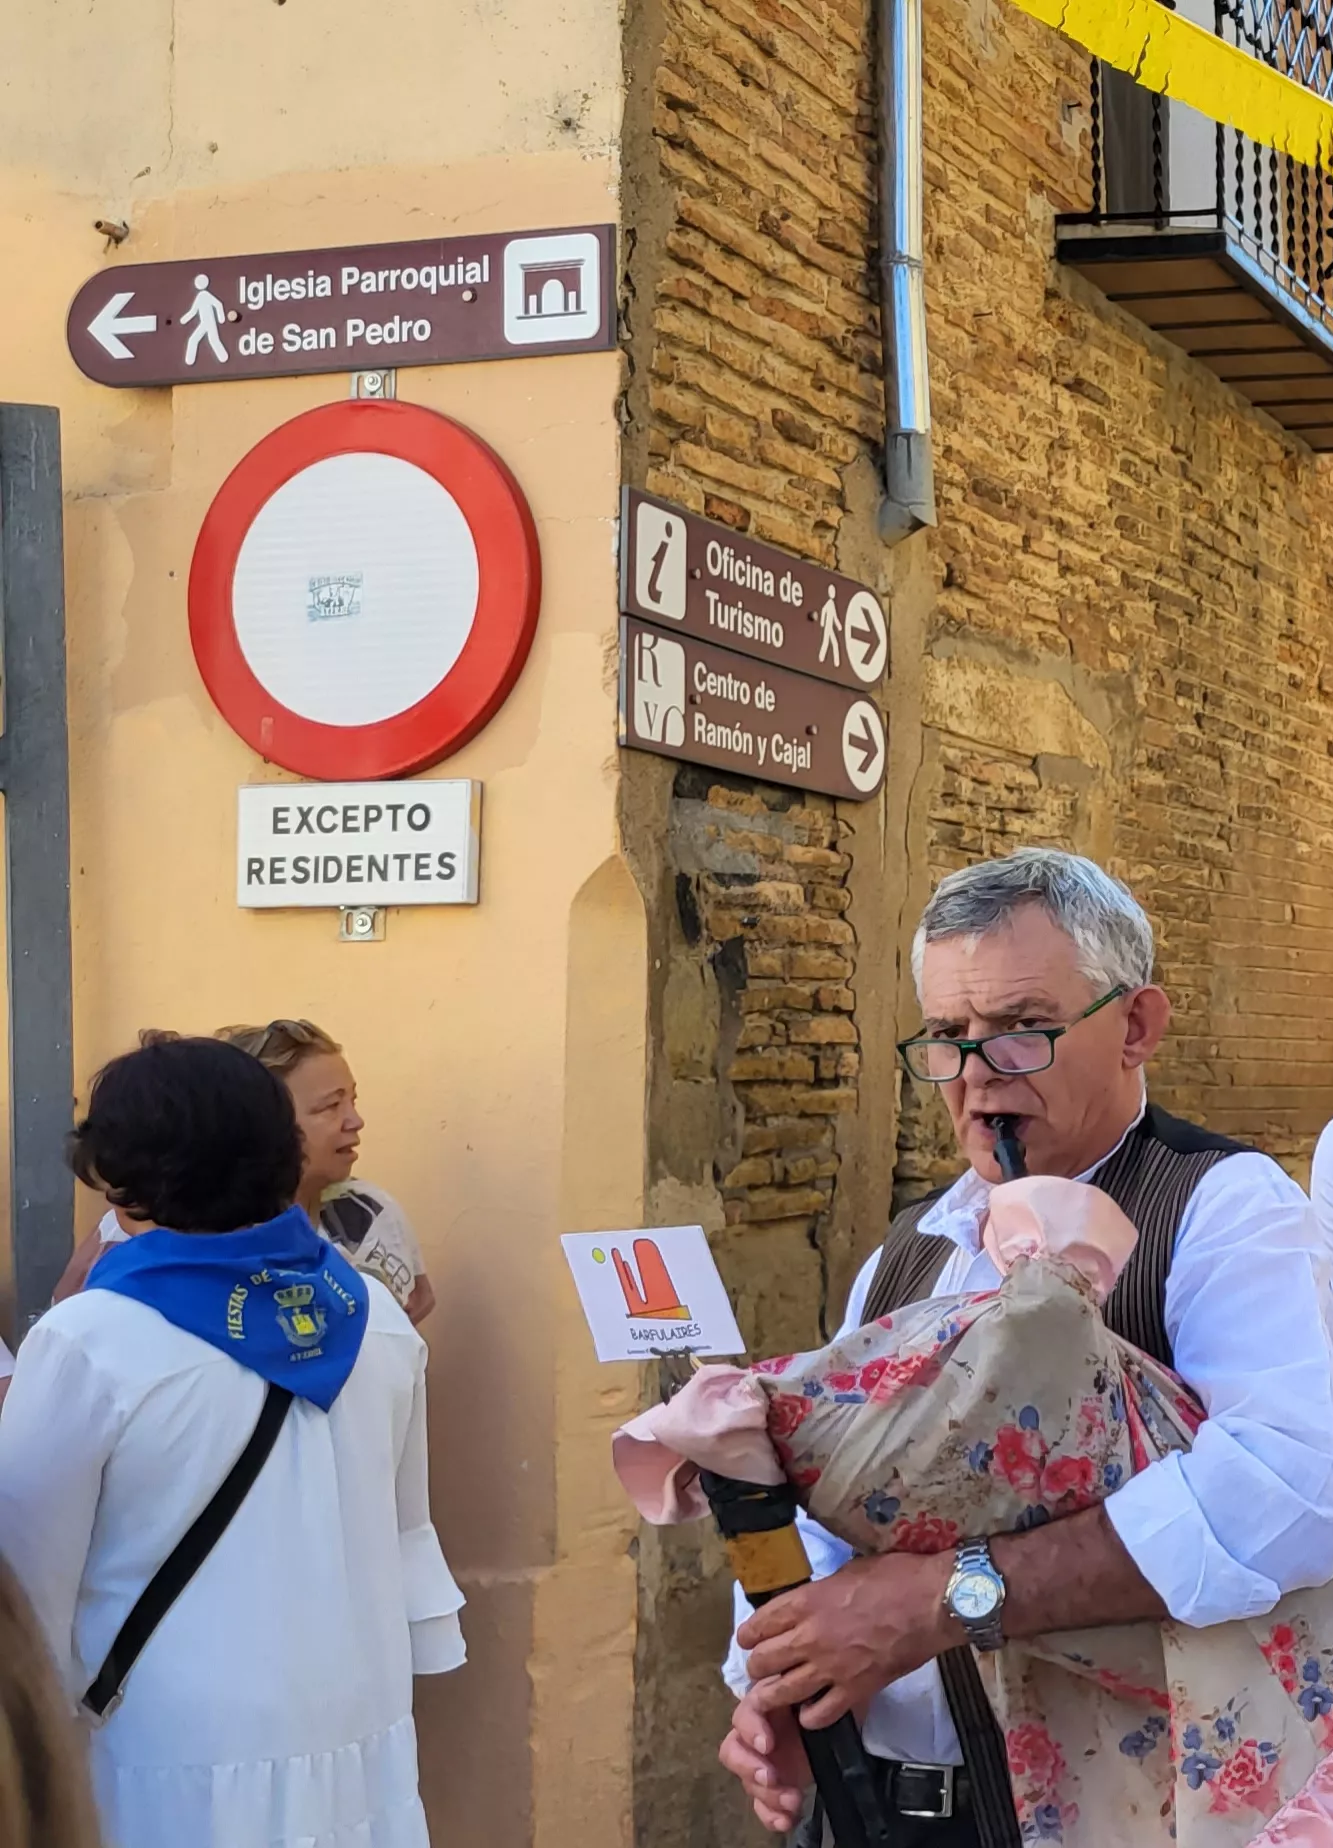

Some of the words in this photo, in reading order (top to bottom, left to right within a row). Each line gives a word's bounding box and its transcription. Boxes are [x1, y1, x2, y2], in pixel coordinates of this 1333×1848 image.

[239, 270, 332, 310] Iglesia
[341, 254, 490, 295] Parroquial
[238, 328, 275, 356] de
[282, 322, 337, 353] San
[346, 315, 432, 347] Pedro
[706, 540, 775, 598] Oficina
[779, 571, 804, 607] de
[705, 589, 785, 648] Turismo
[693, 661, 751, 705] Centro
[754, 681, 776, 712] de
[694, 711, 753, 756] Ramón
[757, 738, 768, 765] y
[771, 733, 811, 773] Cajal
[272, 803, 432, 834] EXCEPTO
[247, 852, 457, 886] RESIDENTES
[227, 1283, 249, 1340] FIESTAS
[250, 1268, 272, 1286] DE
[629, 1323, 702, 1342] BARFULAIRES
